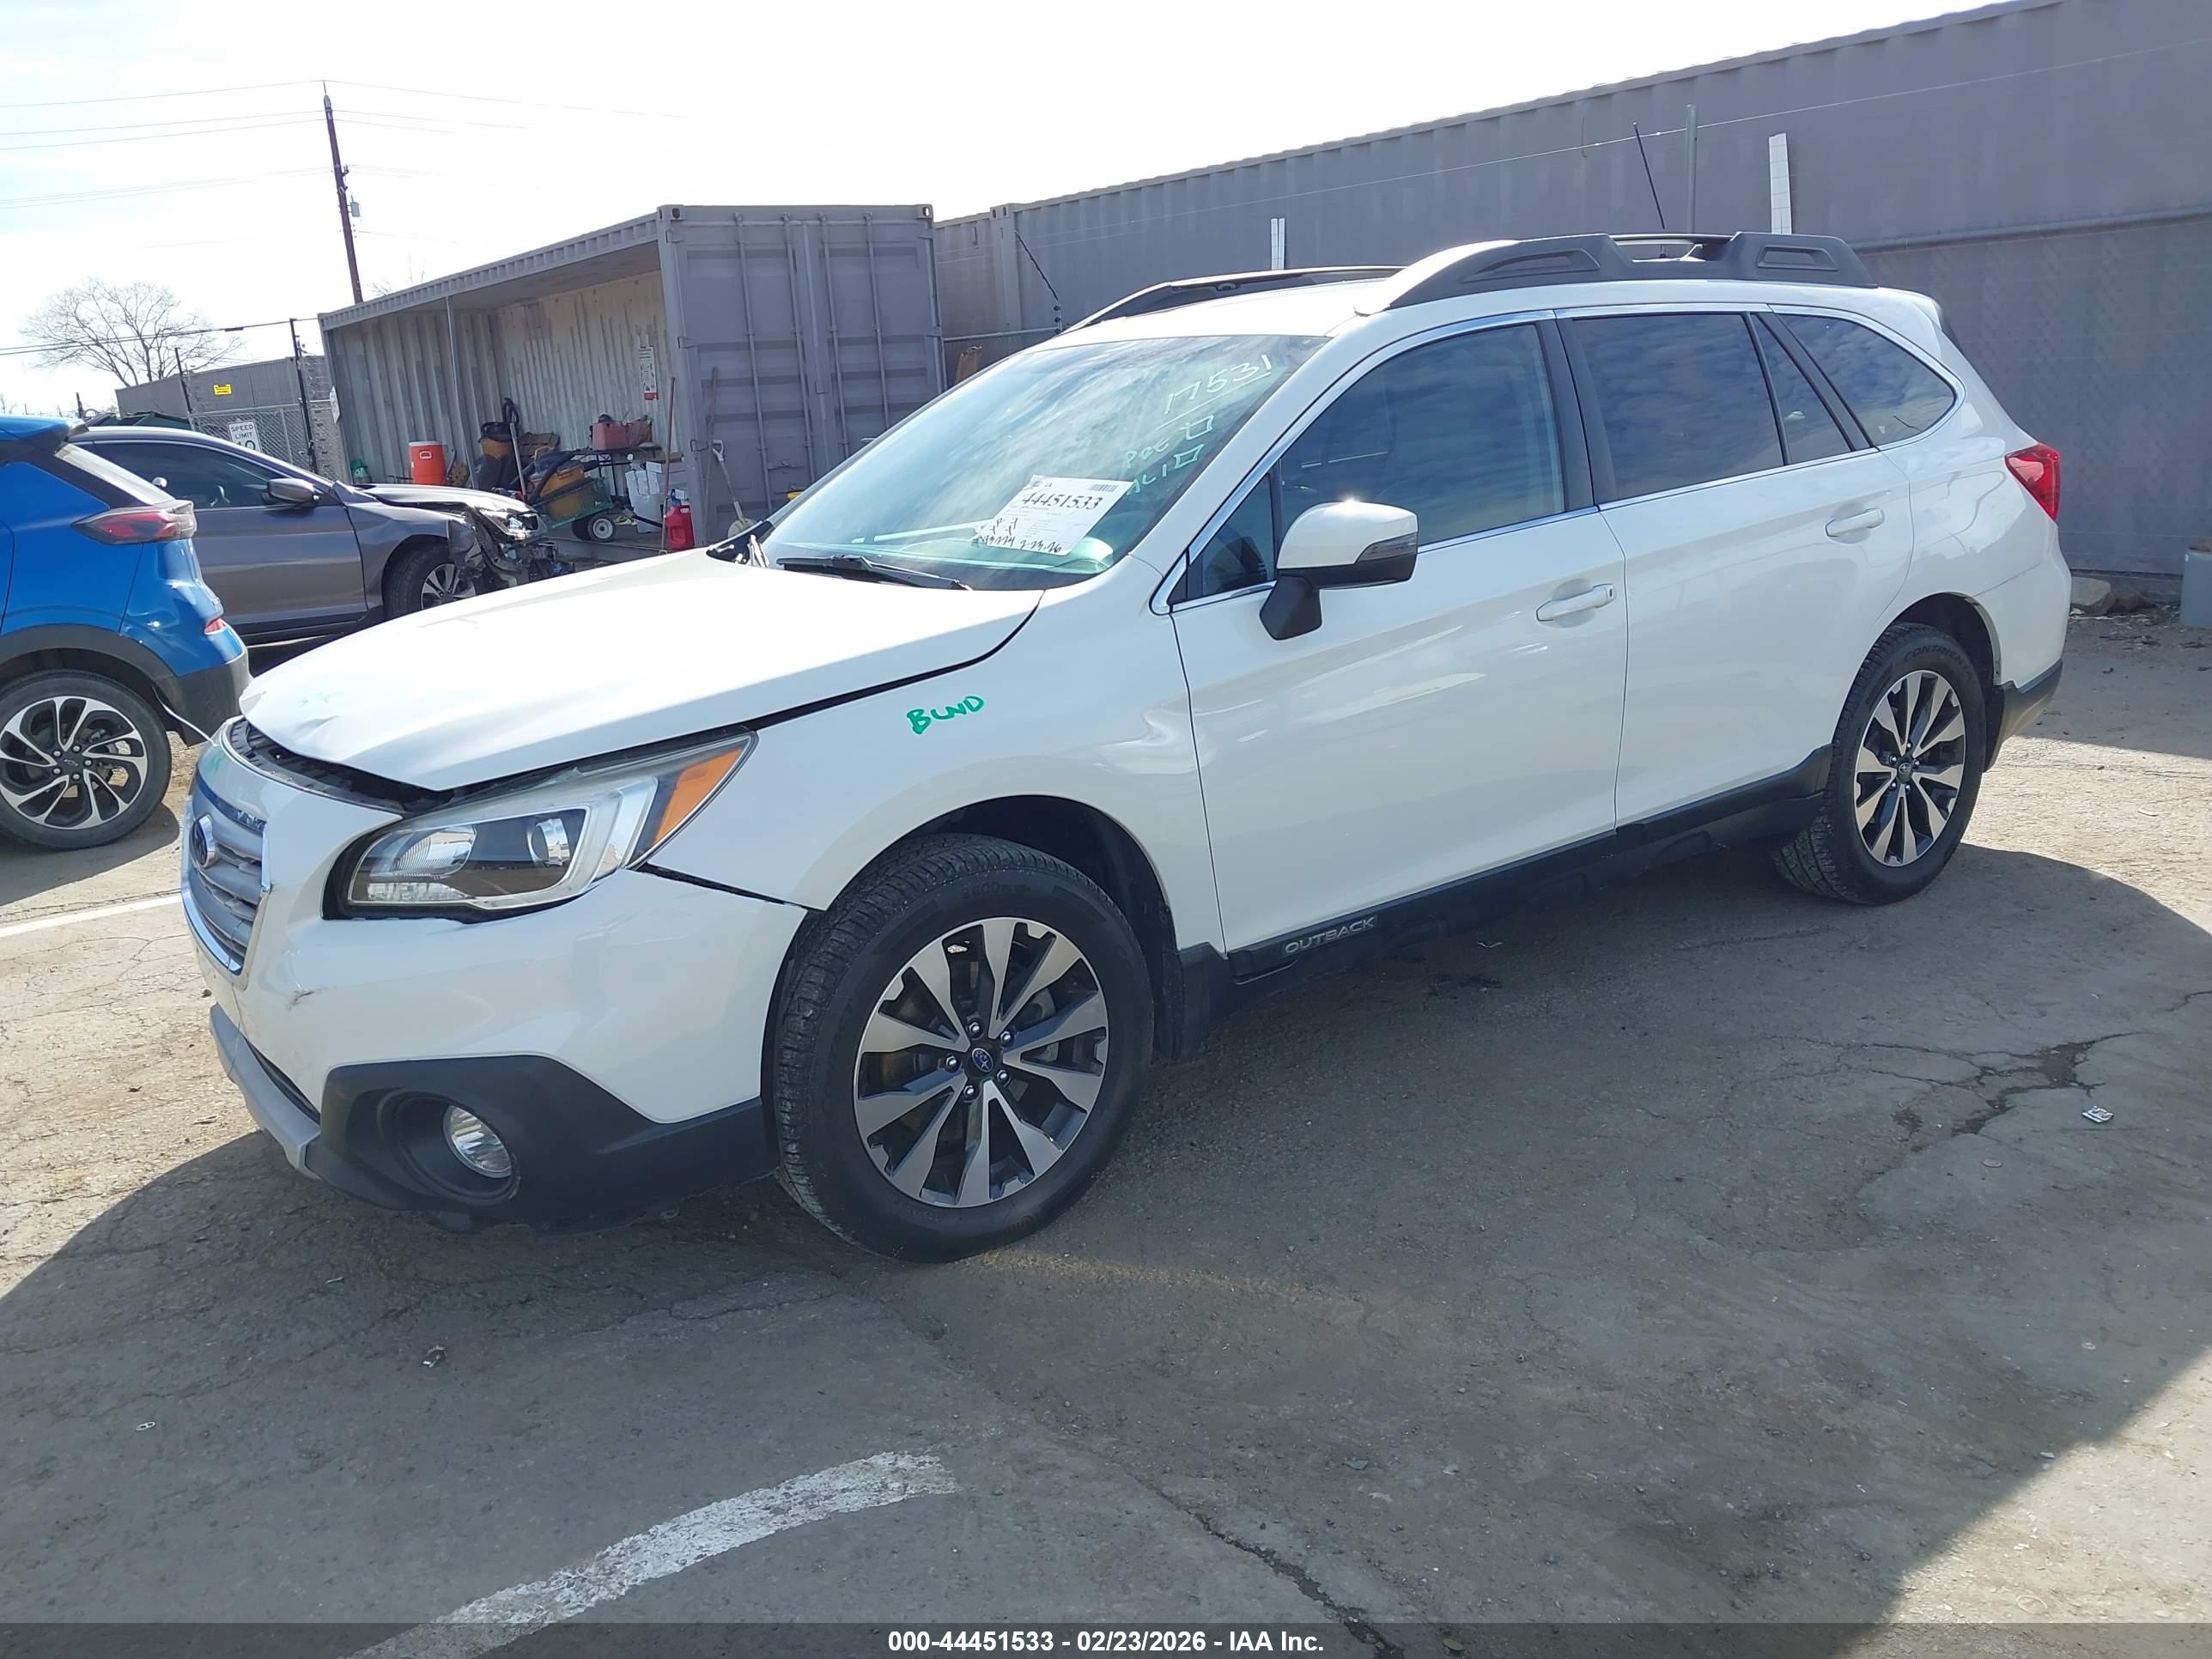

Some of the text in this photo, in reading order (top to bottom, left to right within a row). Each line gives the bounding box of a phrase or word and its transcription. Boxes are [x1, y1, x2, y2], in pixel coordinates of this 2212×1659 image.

[1164, 354, 1272, 415] 17531
[1022, 491, 1103, 510] 44451533
[1285, 916, 1376, 953] OUTBACK
